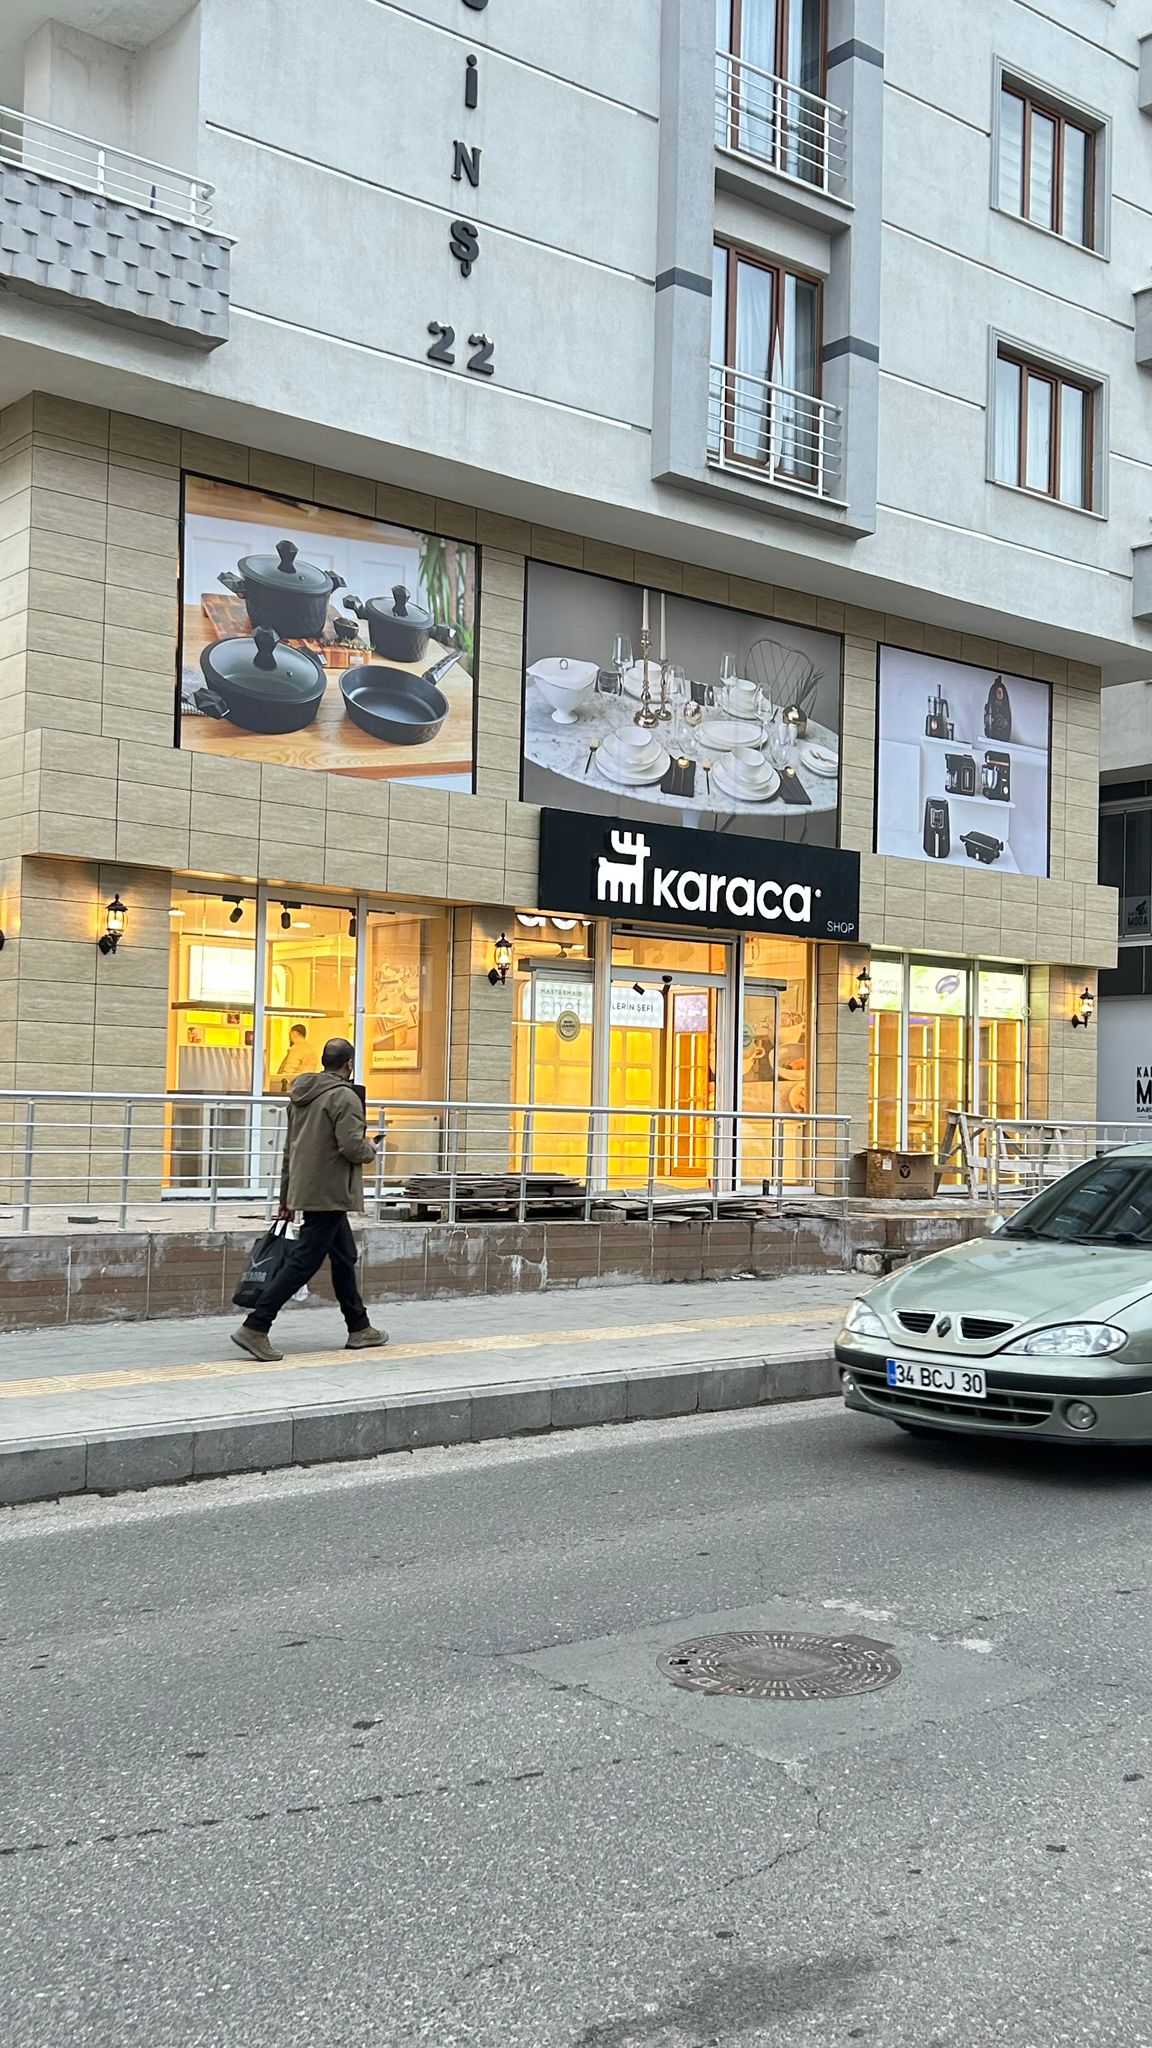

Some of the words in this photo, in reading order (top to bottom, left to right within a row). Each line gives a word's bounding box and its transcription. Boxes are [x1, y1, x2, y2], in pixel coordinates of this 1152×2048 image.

[653, 867, 812, 923] karaca
[826, 919, 856, 934] SHOP
[1136, 1066, 1152, 1078] KA
[896, 1364, 915, 1385] 34
[920, 1367, 955, 1390] BCJ
[962, 1373, 983, 1394] 30
